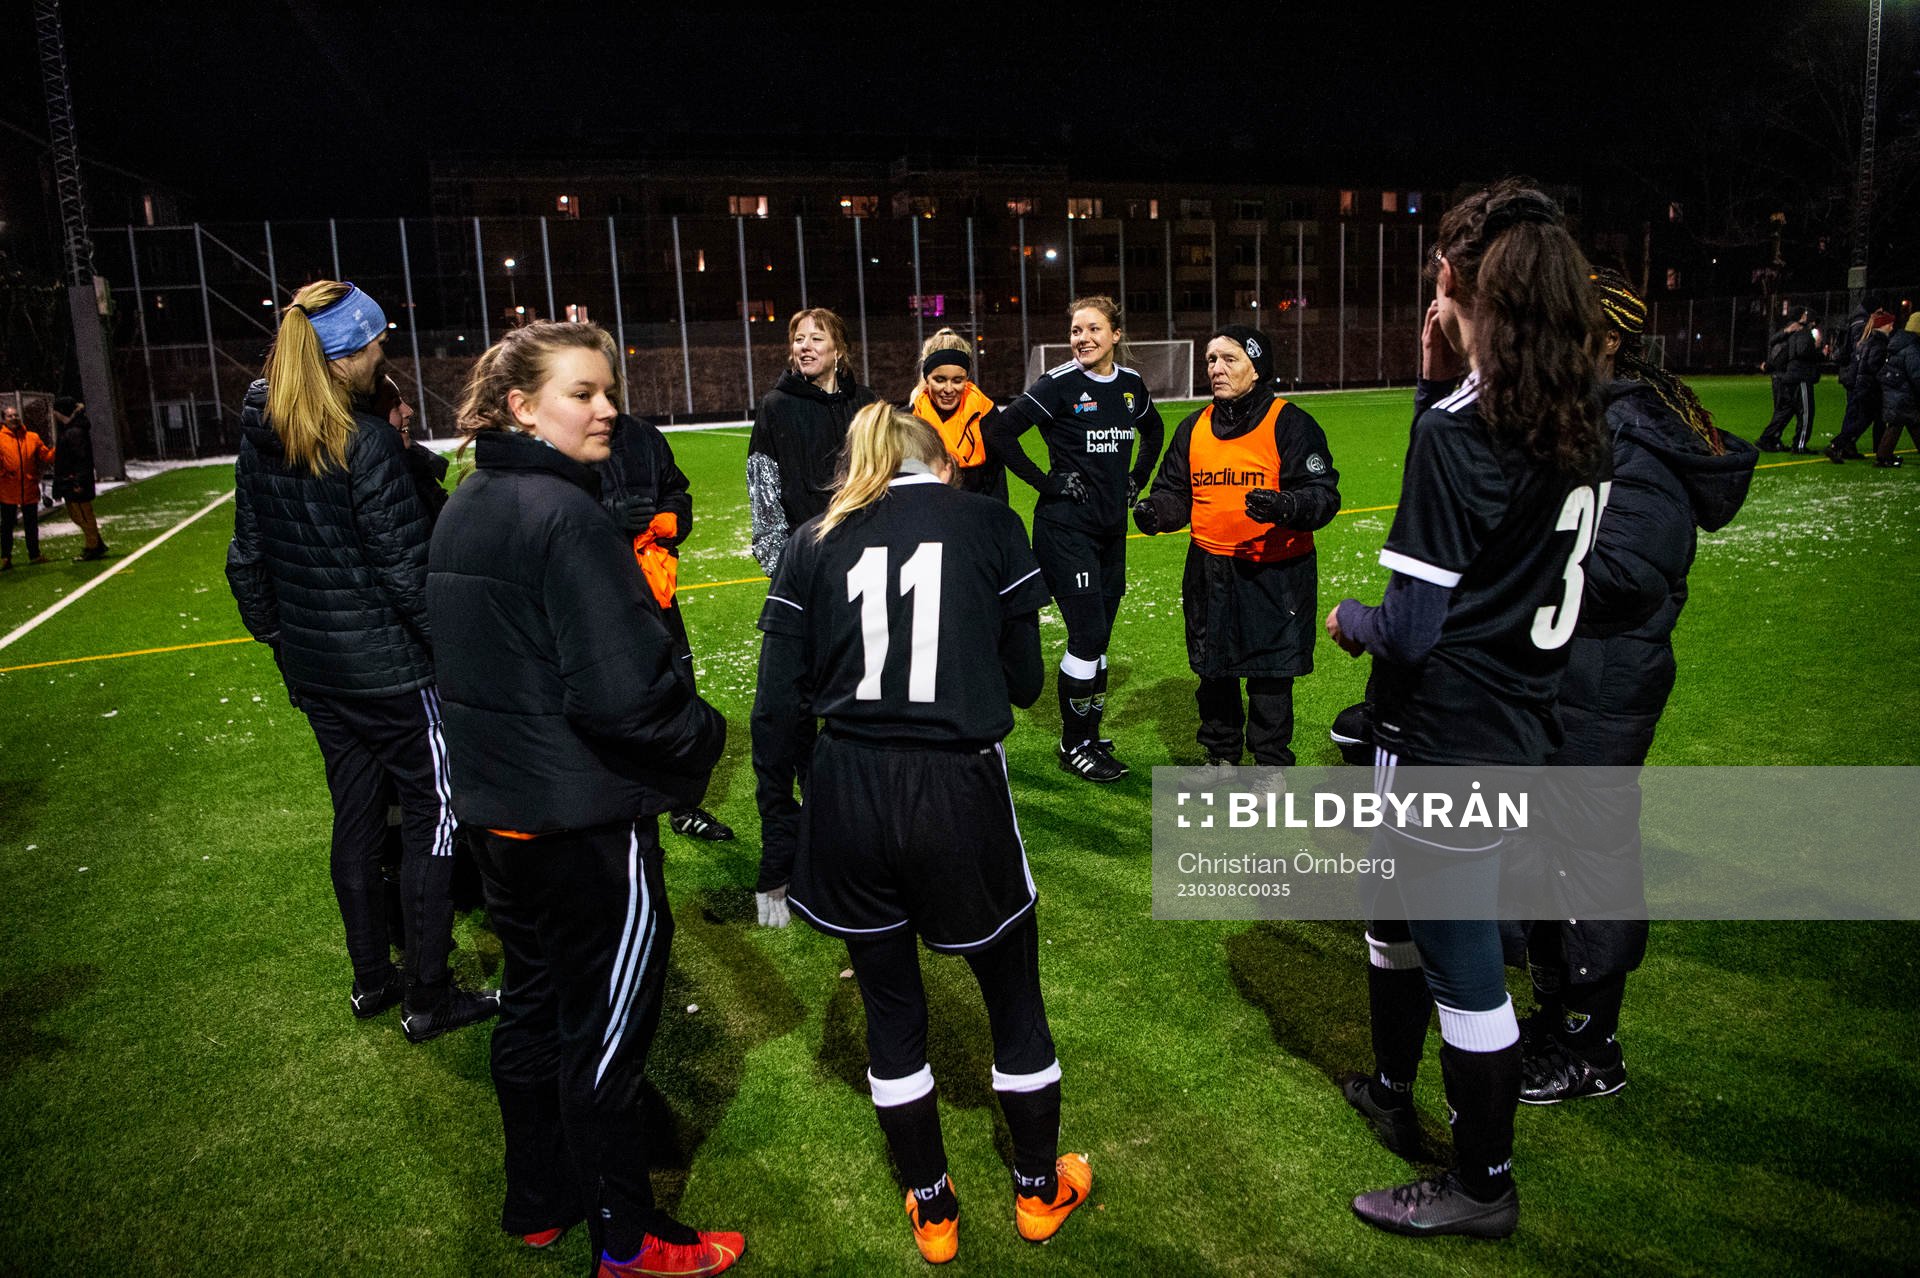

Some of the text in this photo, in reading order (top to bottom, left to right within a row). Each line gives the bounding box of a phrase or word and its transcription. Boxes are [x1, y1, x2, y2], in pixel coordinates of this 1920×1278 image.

[1086, 440, 1119, 454] bank
[1191, 467, 1265, 487] stadium
[1075, 571, 1090, 589] 17
[846, 542, 943, 703] 11
